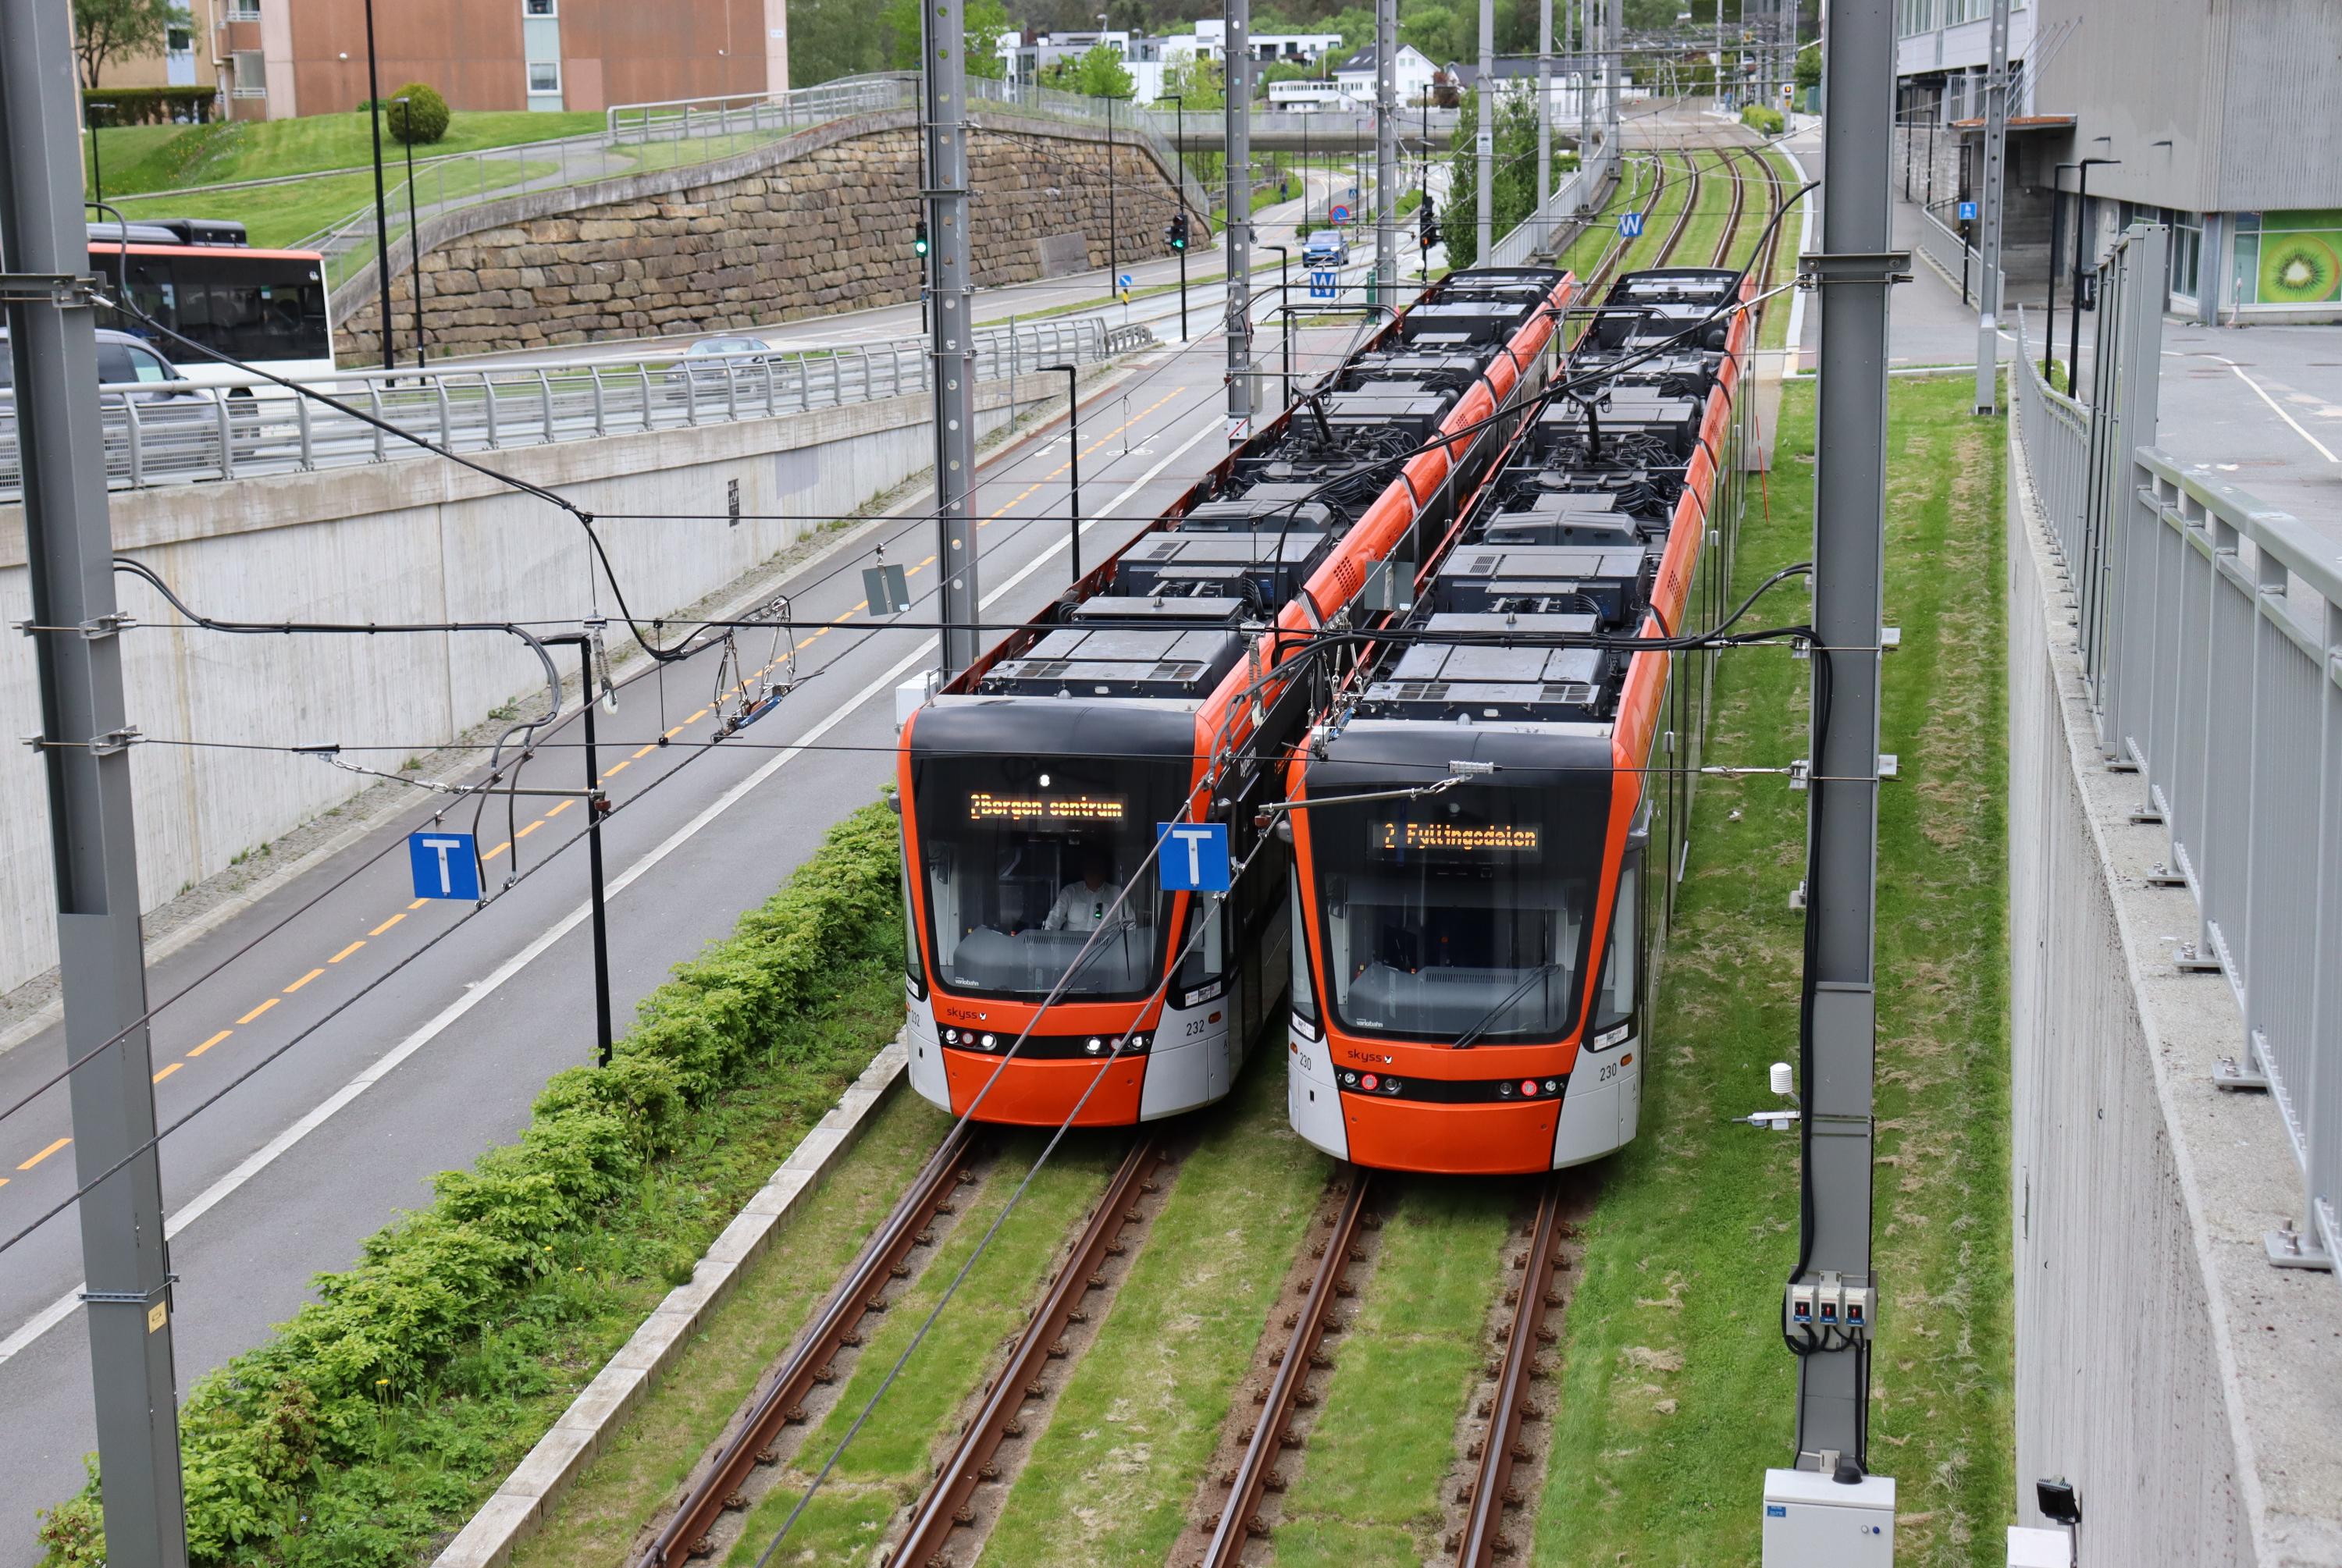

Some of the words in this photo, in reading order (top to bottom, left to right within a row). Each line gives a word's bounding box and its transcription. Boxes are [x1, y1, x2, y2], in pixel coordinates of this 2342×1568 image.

[1620, 214, 1640, 235] W
[1312, 274, 1335, 296] W
[1049, 795, 1122, 817] sentrum
[1384, 823, 1395, 848] 2
[1407, 823, 1536, 850] Fyllingsdalen
[422, 839, 460, 893] T
[1173, 830, 1212, 884] T
[955, 976, 979, 987] variobahn
[911, 1010, 920, 1027] 232
[946, 1007, 977, 1020] skyss
[1356, 1018, 1383, 1028] variobahn
[1186, 1019, 1205, 1037] 232
[1300, 1052, 1312, 1071] 230
[1347, 1049, 1382, 1063] skyss
[1600, 1062, 1617, 1082] 230
